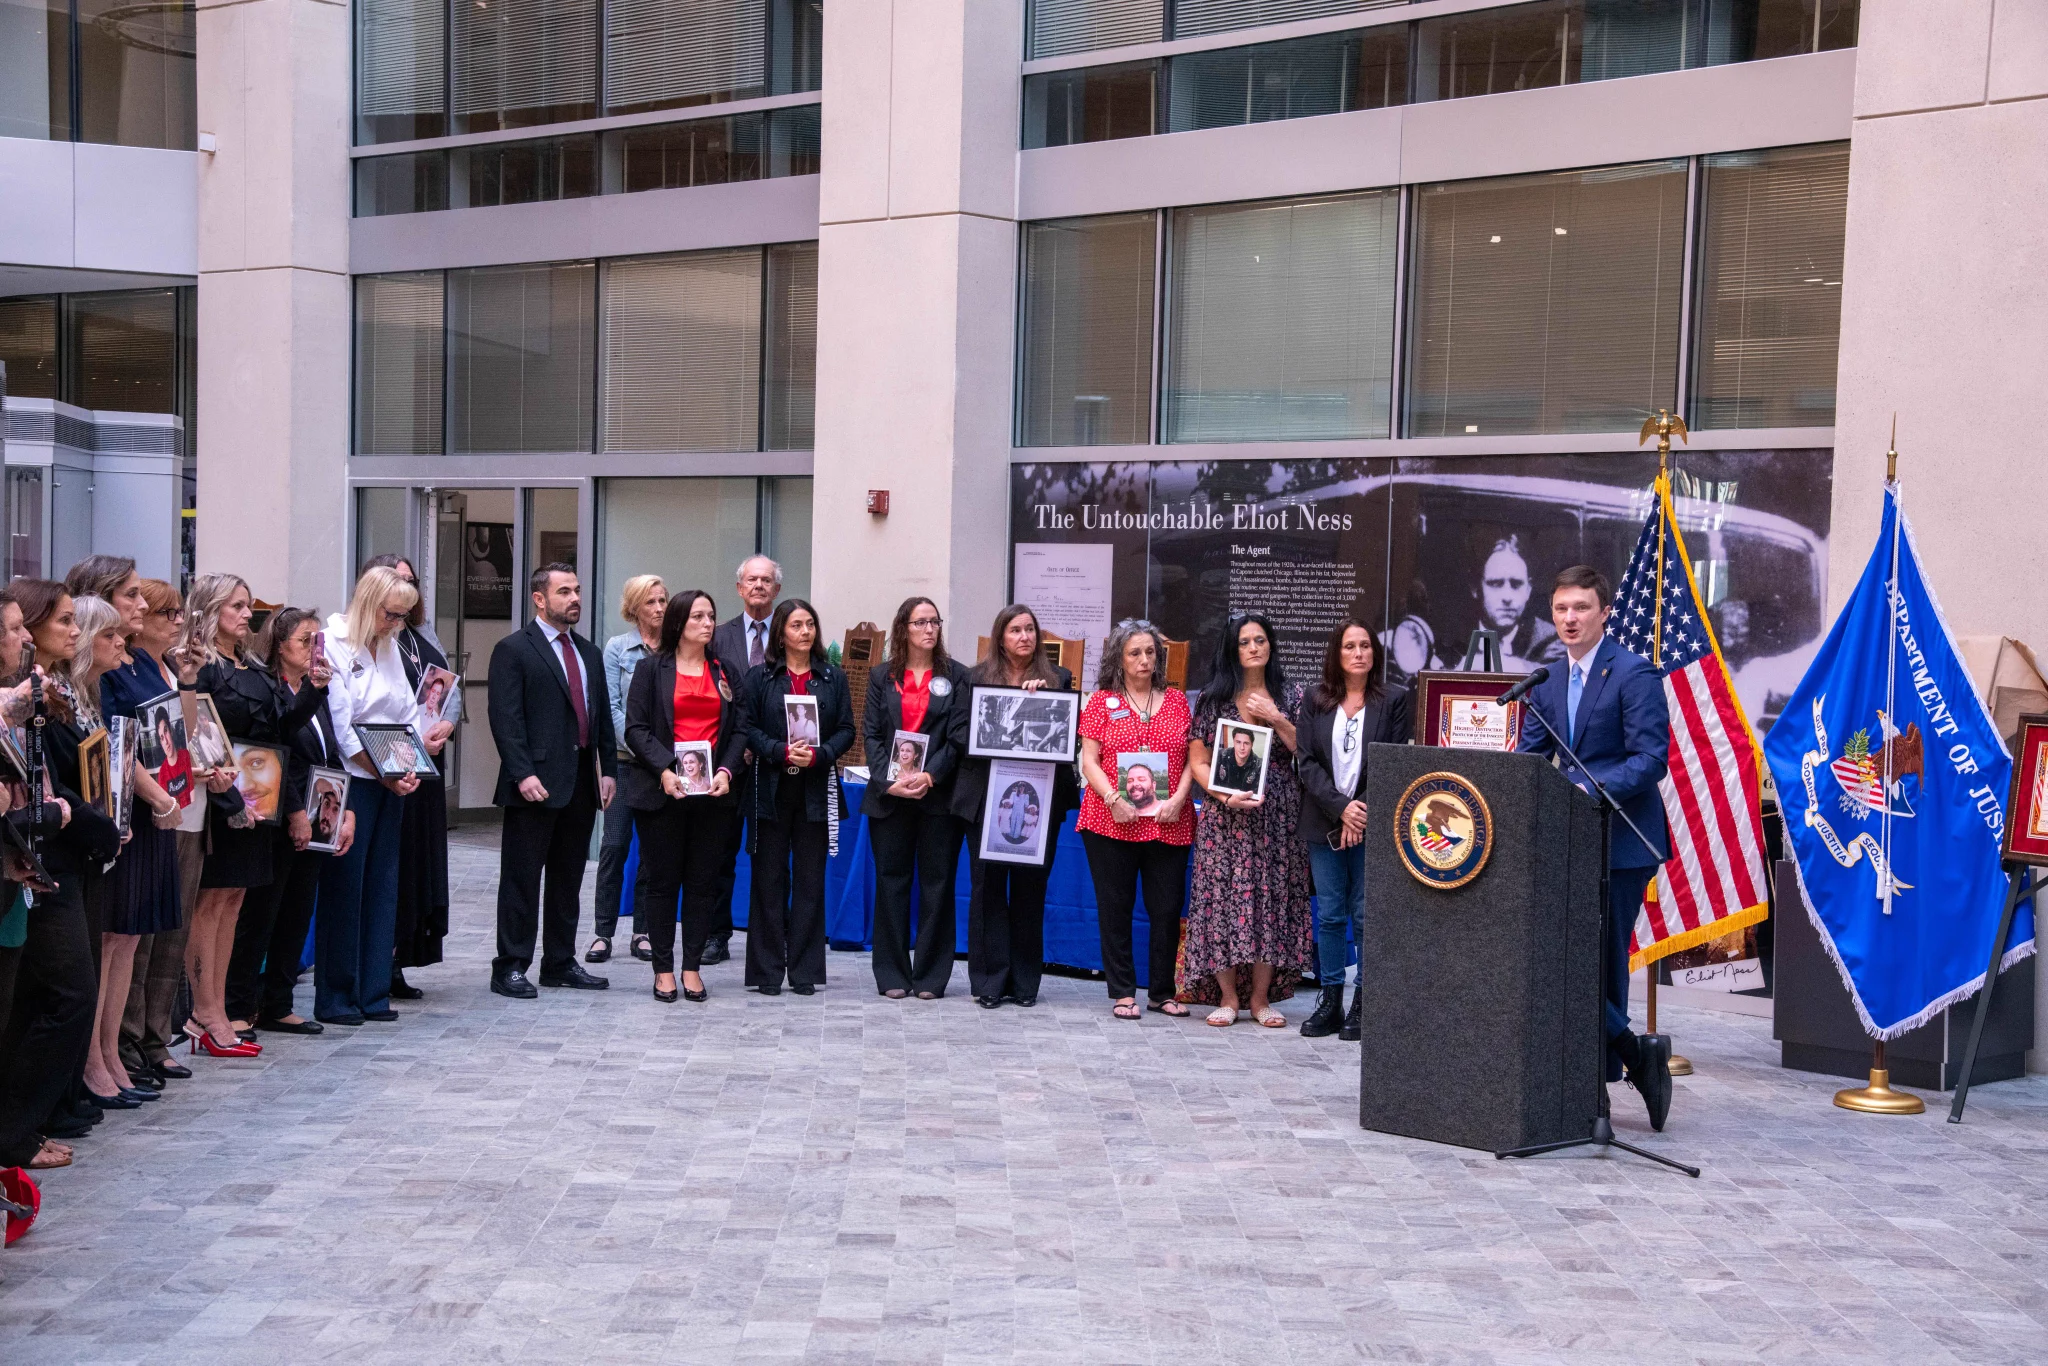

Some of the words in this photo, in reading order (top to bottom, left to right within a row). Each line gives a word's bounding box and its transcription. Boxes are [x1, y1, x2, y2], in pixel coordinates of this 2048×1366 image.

[1034, 504, 1074, 530] The
[1082, 504, 1224, 530] Untouchable
[1231, 504, 1288, 530] Eliot
[1296, 504, 1352, 531] Ness
[1231, 545, 1246, 554] The
[1247, 545, 1270, 558] Agent
[1400, 780, 1445, 841] DEPARTMENT
[1449, 783, 1464, 796] OF
[1464, 796, 1484, 848] JUSTICE
[1803, 762, 1816, 807] DOMINA
[1817, 821, 1847, 864] JUSTITIA
[1948, 744, 1979, 775] OF
[1969, 784, 2004, 854] JUST
[1686, 970, 1722, 984] Eliot
[1724, 961, 1759, 983] Ness
